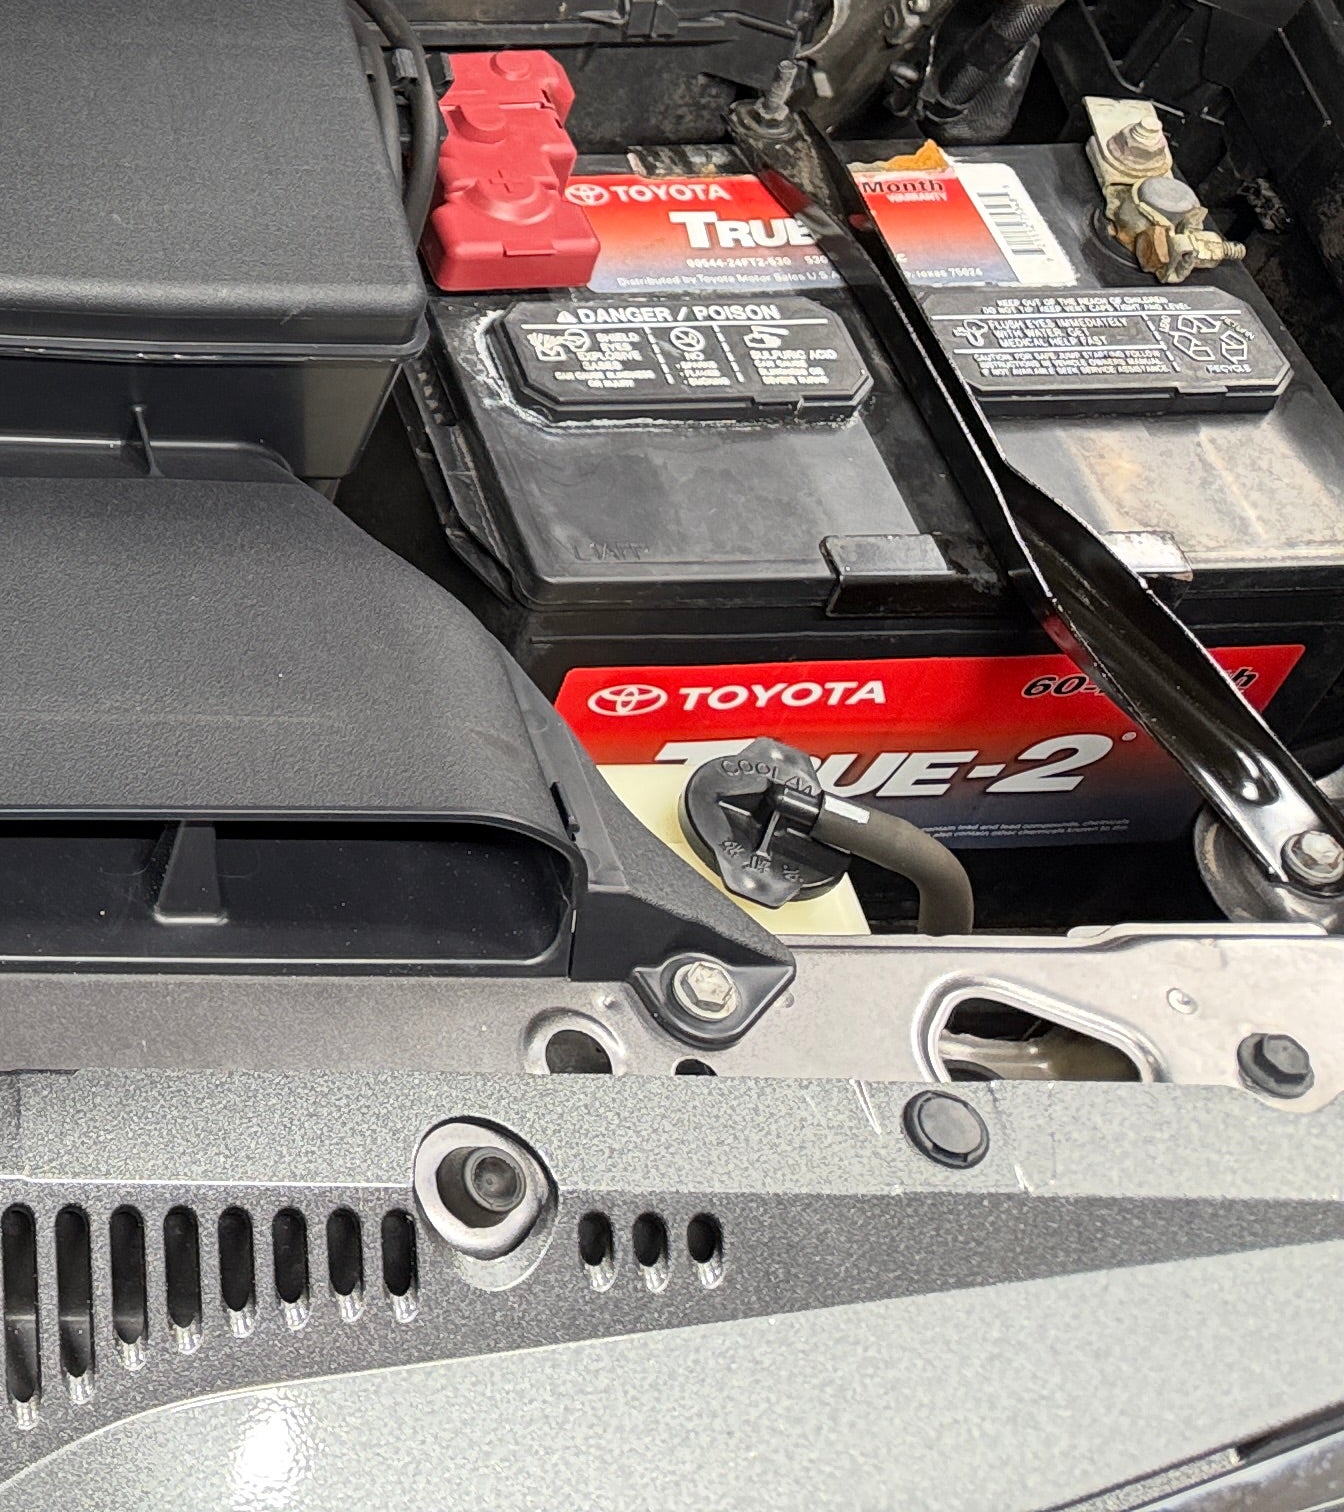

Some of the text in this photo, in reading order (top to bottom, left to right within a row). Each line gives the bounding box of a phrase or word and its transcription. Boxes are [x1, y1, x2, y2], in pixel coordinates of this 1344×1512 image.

[609, 183, 734, 203] TOYOTA
[862, 180, 943, 193] Month
[577, 306, 674, 324] DANGER
[692, 303, 782, 321] POISON
[987, 317, 1128, 330] FLUSH EYES IMMEDIATELY
[992, 328, 1023, 339] WITH
[998, 335, 1108, 348] MEDICAL HELP FAST
[679, 679, 887, 712] TOYOTA
